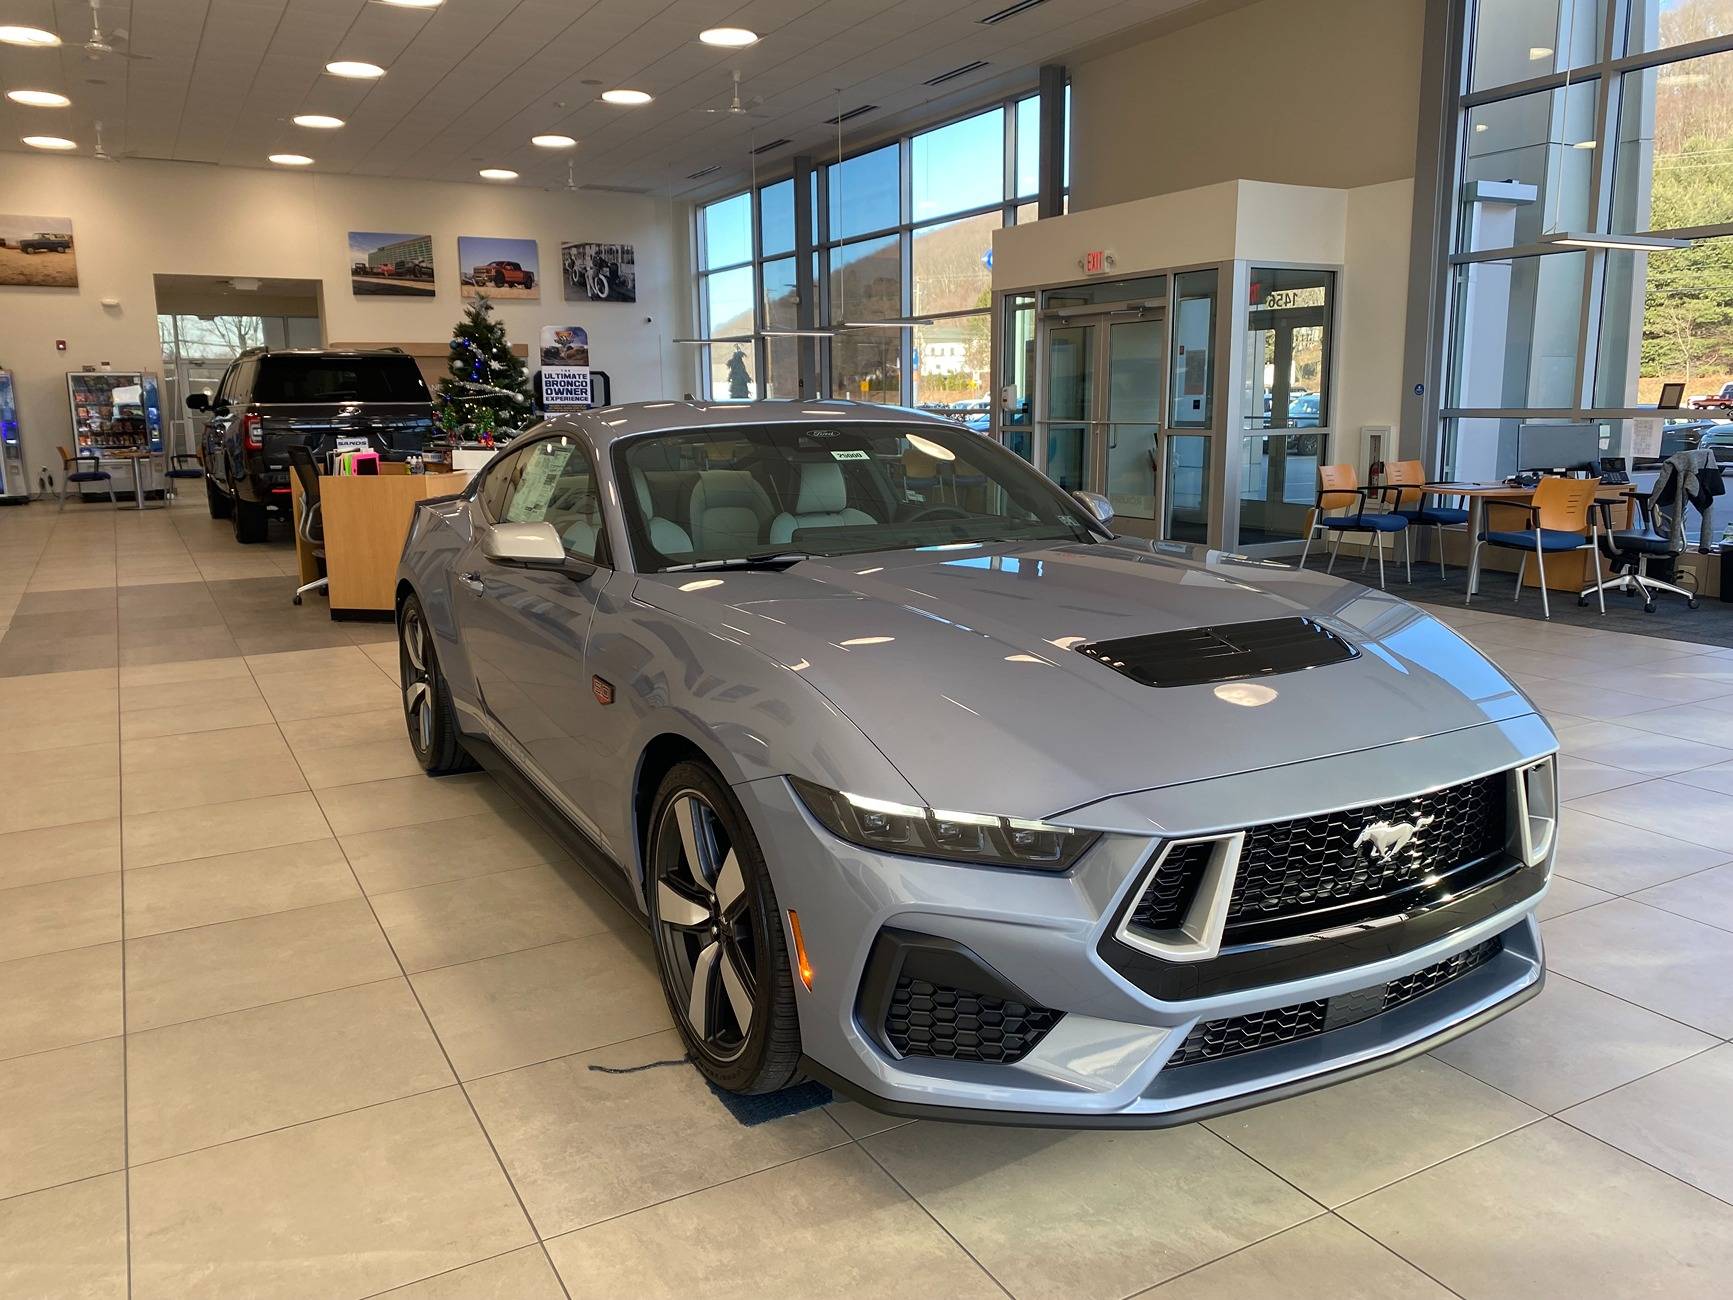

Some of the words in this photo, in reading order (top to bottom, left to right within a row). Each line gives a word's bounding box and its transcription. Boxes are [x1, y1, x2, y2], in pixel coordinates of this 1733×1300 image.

[1087, 251, 1104, 272] EXIT
[544, 380, 588, 388] BRONCO
[545, 388, 588, 396] OWNER
